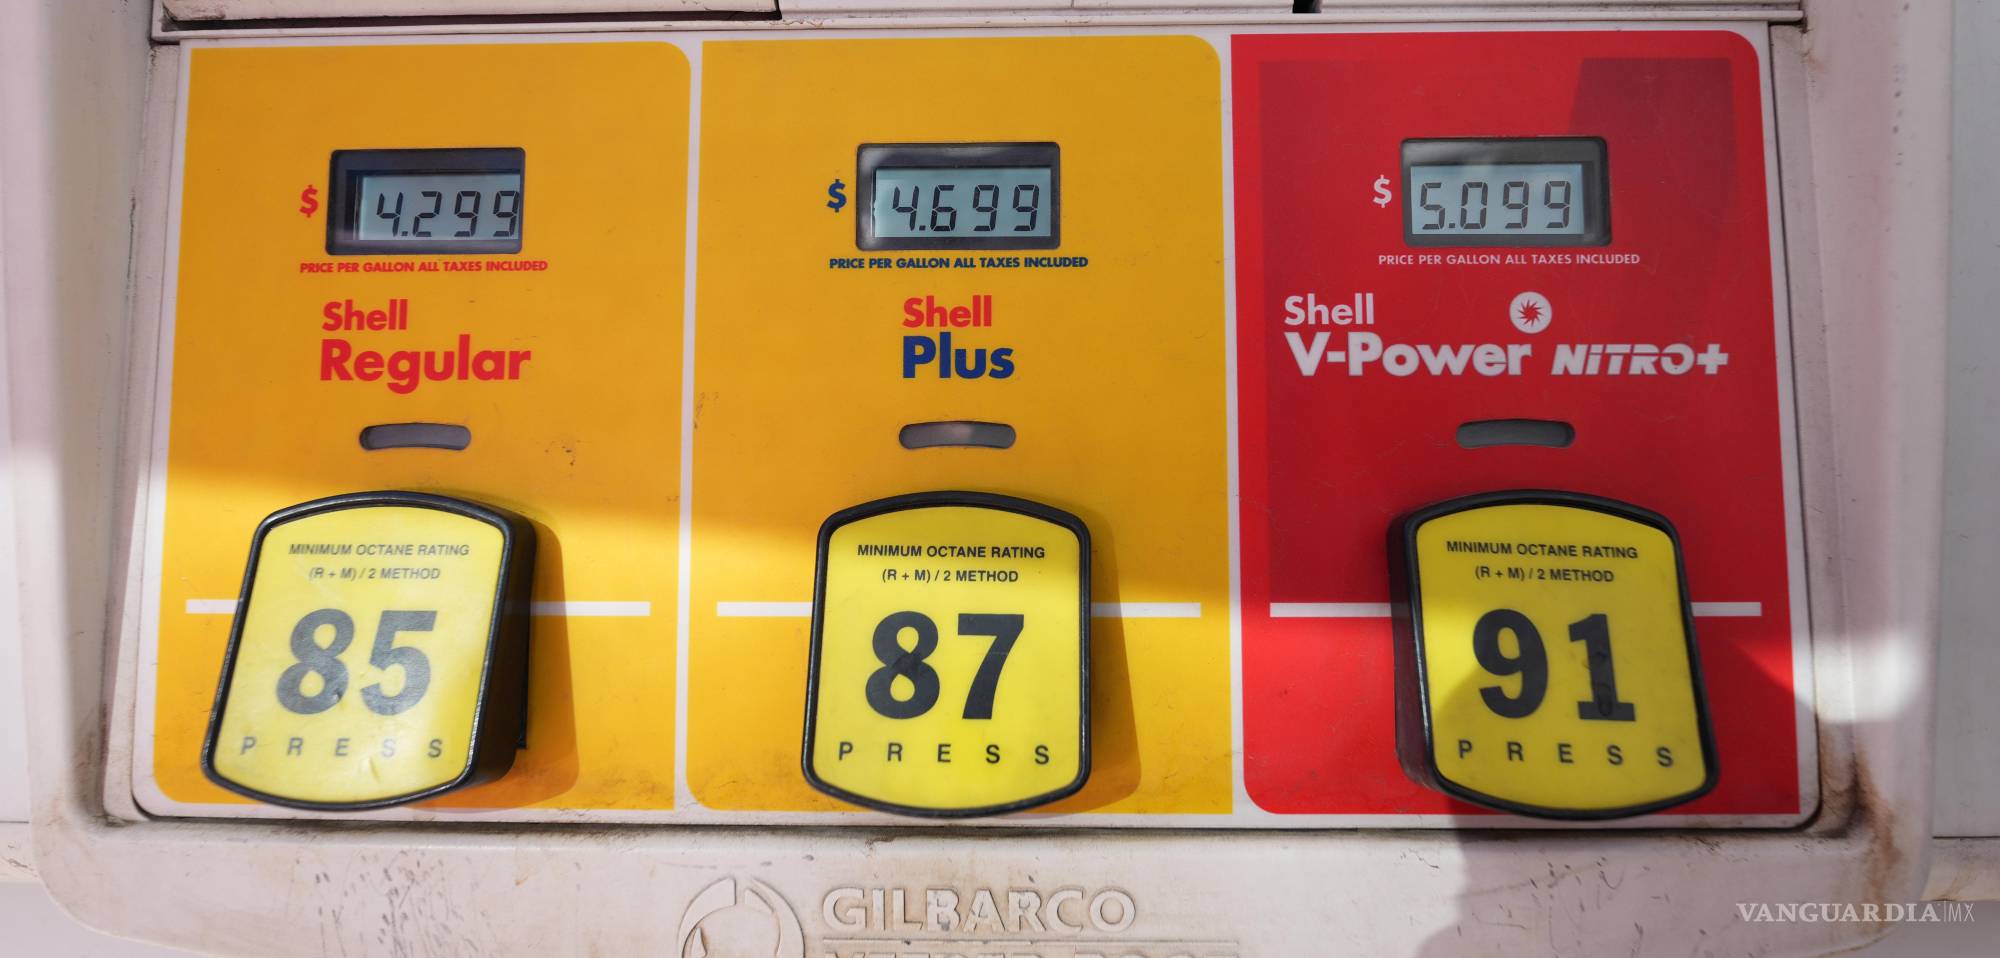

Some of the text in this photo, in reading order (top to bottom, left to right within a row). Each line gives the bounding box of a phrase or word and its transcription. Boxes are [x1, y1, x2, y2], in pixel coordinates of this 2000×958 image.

[299, 184, 520, 237] $ 4.299
[826, 179, 1040, 231] $ 4.699
[1373, 175, 1571, 230] $ 5.099
[300, 260, 548, 273] PRICE PER GALLON ALL TAXES INCLUDED
[829, 257, 1088, 269] PRICE PER GALLON ALL TAXES INCLUDED
[1378, 254, 1640, 265] PRICE PER GALLON ALL TAXES INCLUDED
[322, 299, 408, 331] Shell
[902, 295, 992, 328] Shell
[1284, 293, 1374, 325] Shell
[320, 334, 531, 394] Regular
[902, 332, 1015, 379] Plus
[1284, 332, 1532, 377] V-Power
[289, 544, 470, 556] MINIMUM OCTANE RATING
[857, 544, 1045, 559] MINIMUM OCTANE RATING
[1446, 541, 1639, 559] MINIMUM OCTANE RATING
[380, 568, 441, 579] METHOD
[956, 570, 1019, 583] METHOD
[1550, 569, 1615, 582] METHOD
[276, 608, 438, 716] 85
[865, 610, 1025, 720] 87
[1473, 609, 1636, 722] 91
[822, 886, 1137, 933] GILBARCO
